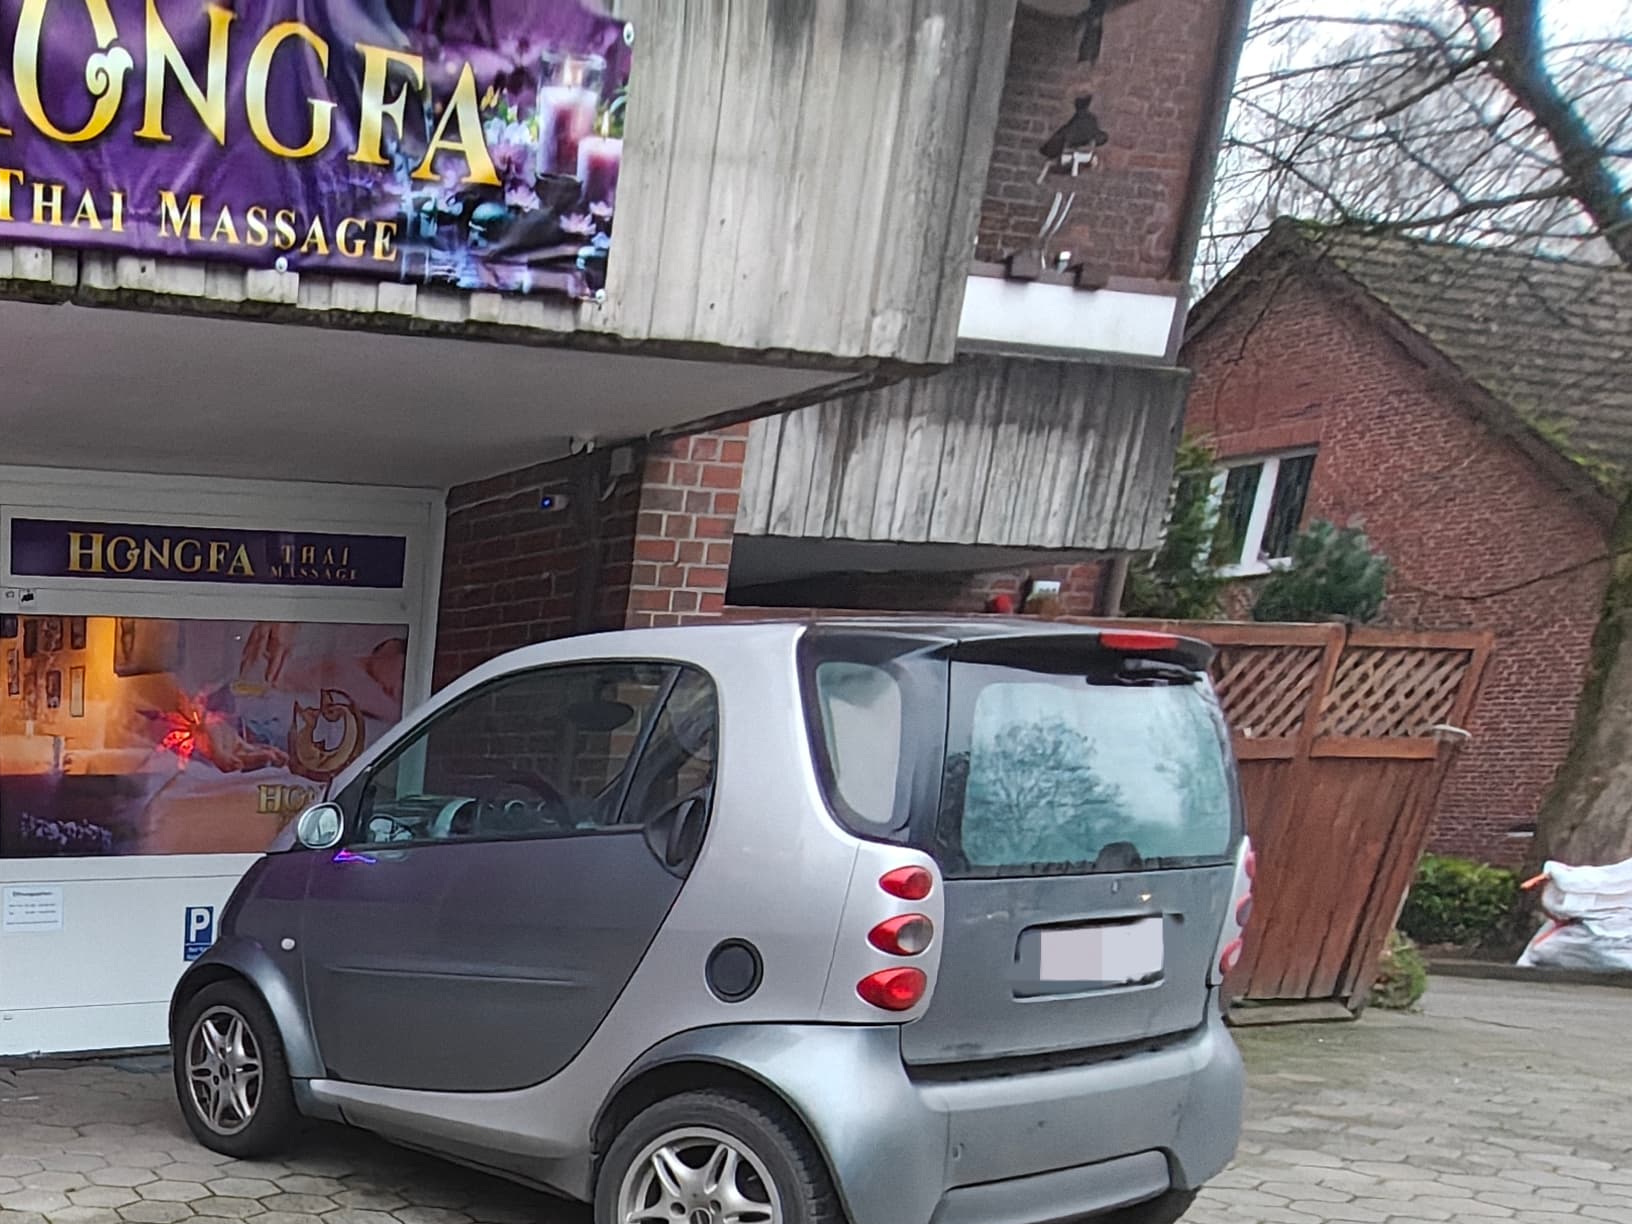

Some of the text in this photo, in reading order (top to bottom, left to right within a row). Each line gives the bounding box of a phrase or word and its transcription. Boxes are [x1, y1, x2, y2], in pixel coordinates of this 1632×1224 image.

[159, 190, 398, 262] MASSAGE
[68, 532, 350, 576] HONGFA THAI
[271, 566, 358, 580] MASSAGE
[190, 908, 210, 942] P
